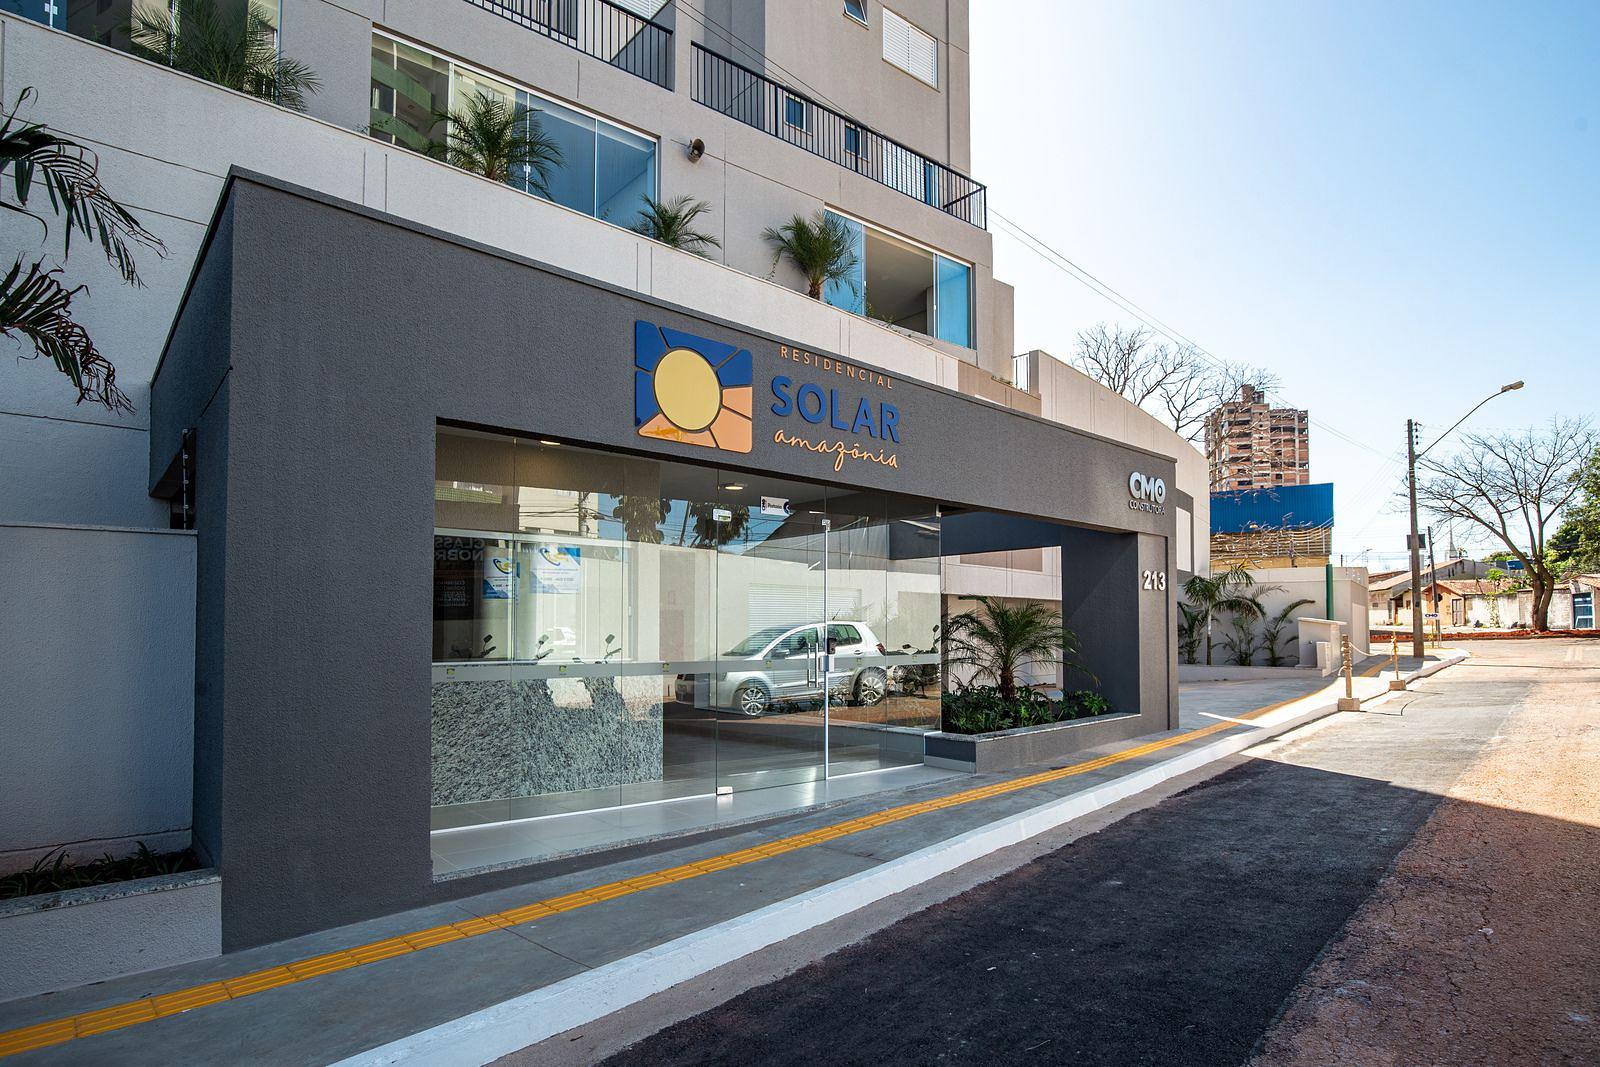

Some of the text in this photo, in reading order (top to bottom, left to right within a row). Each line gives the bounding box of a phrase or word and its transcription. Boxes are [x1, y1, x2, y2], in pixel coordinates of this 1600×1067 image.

[780, 346, 893, 389] RESIDENCIAL
[770, 375, 900, 443] SOLAR
[774, 429, 898, 472] amazônia
[1128, 471, 1166, 504] CMO
[1128, 499, 1166, 515] CONSTRUTORA
[1143, 569, 1166, 591] 213
